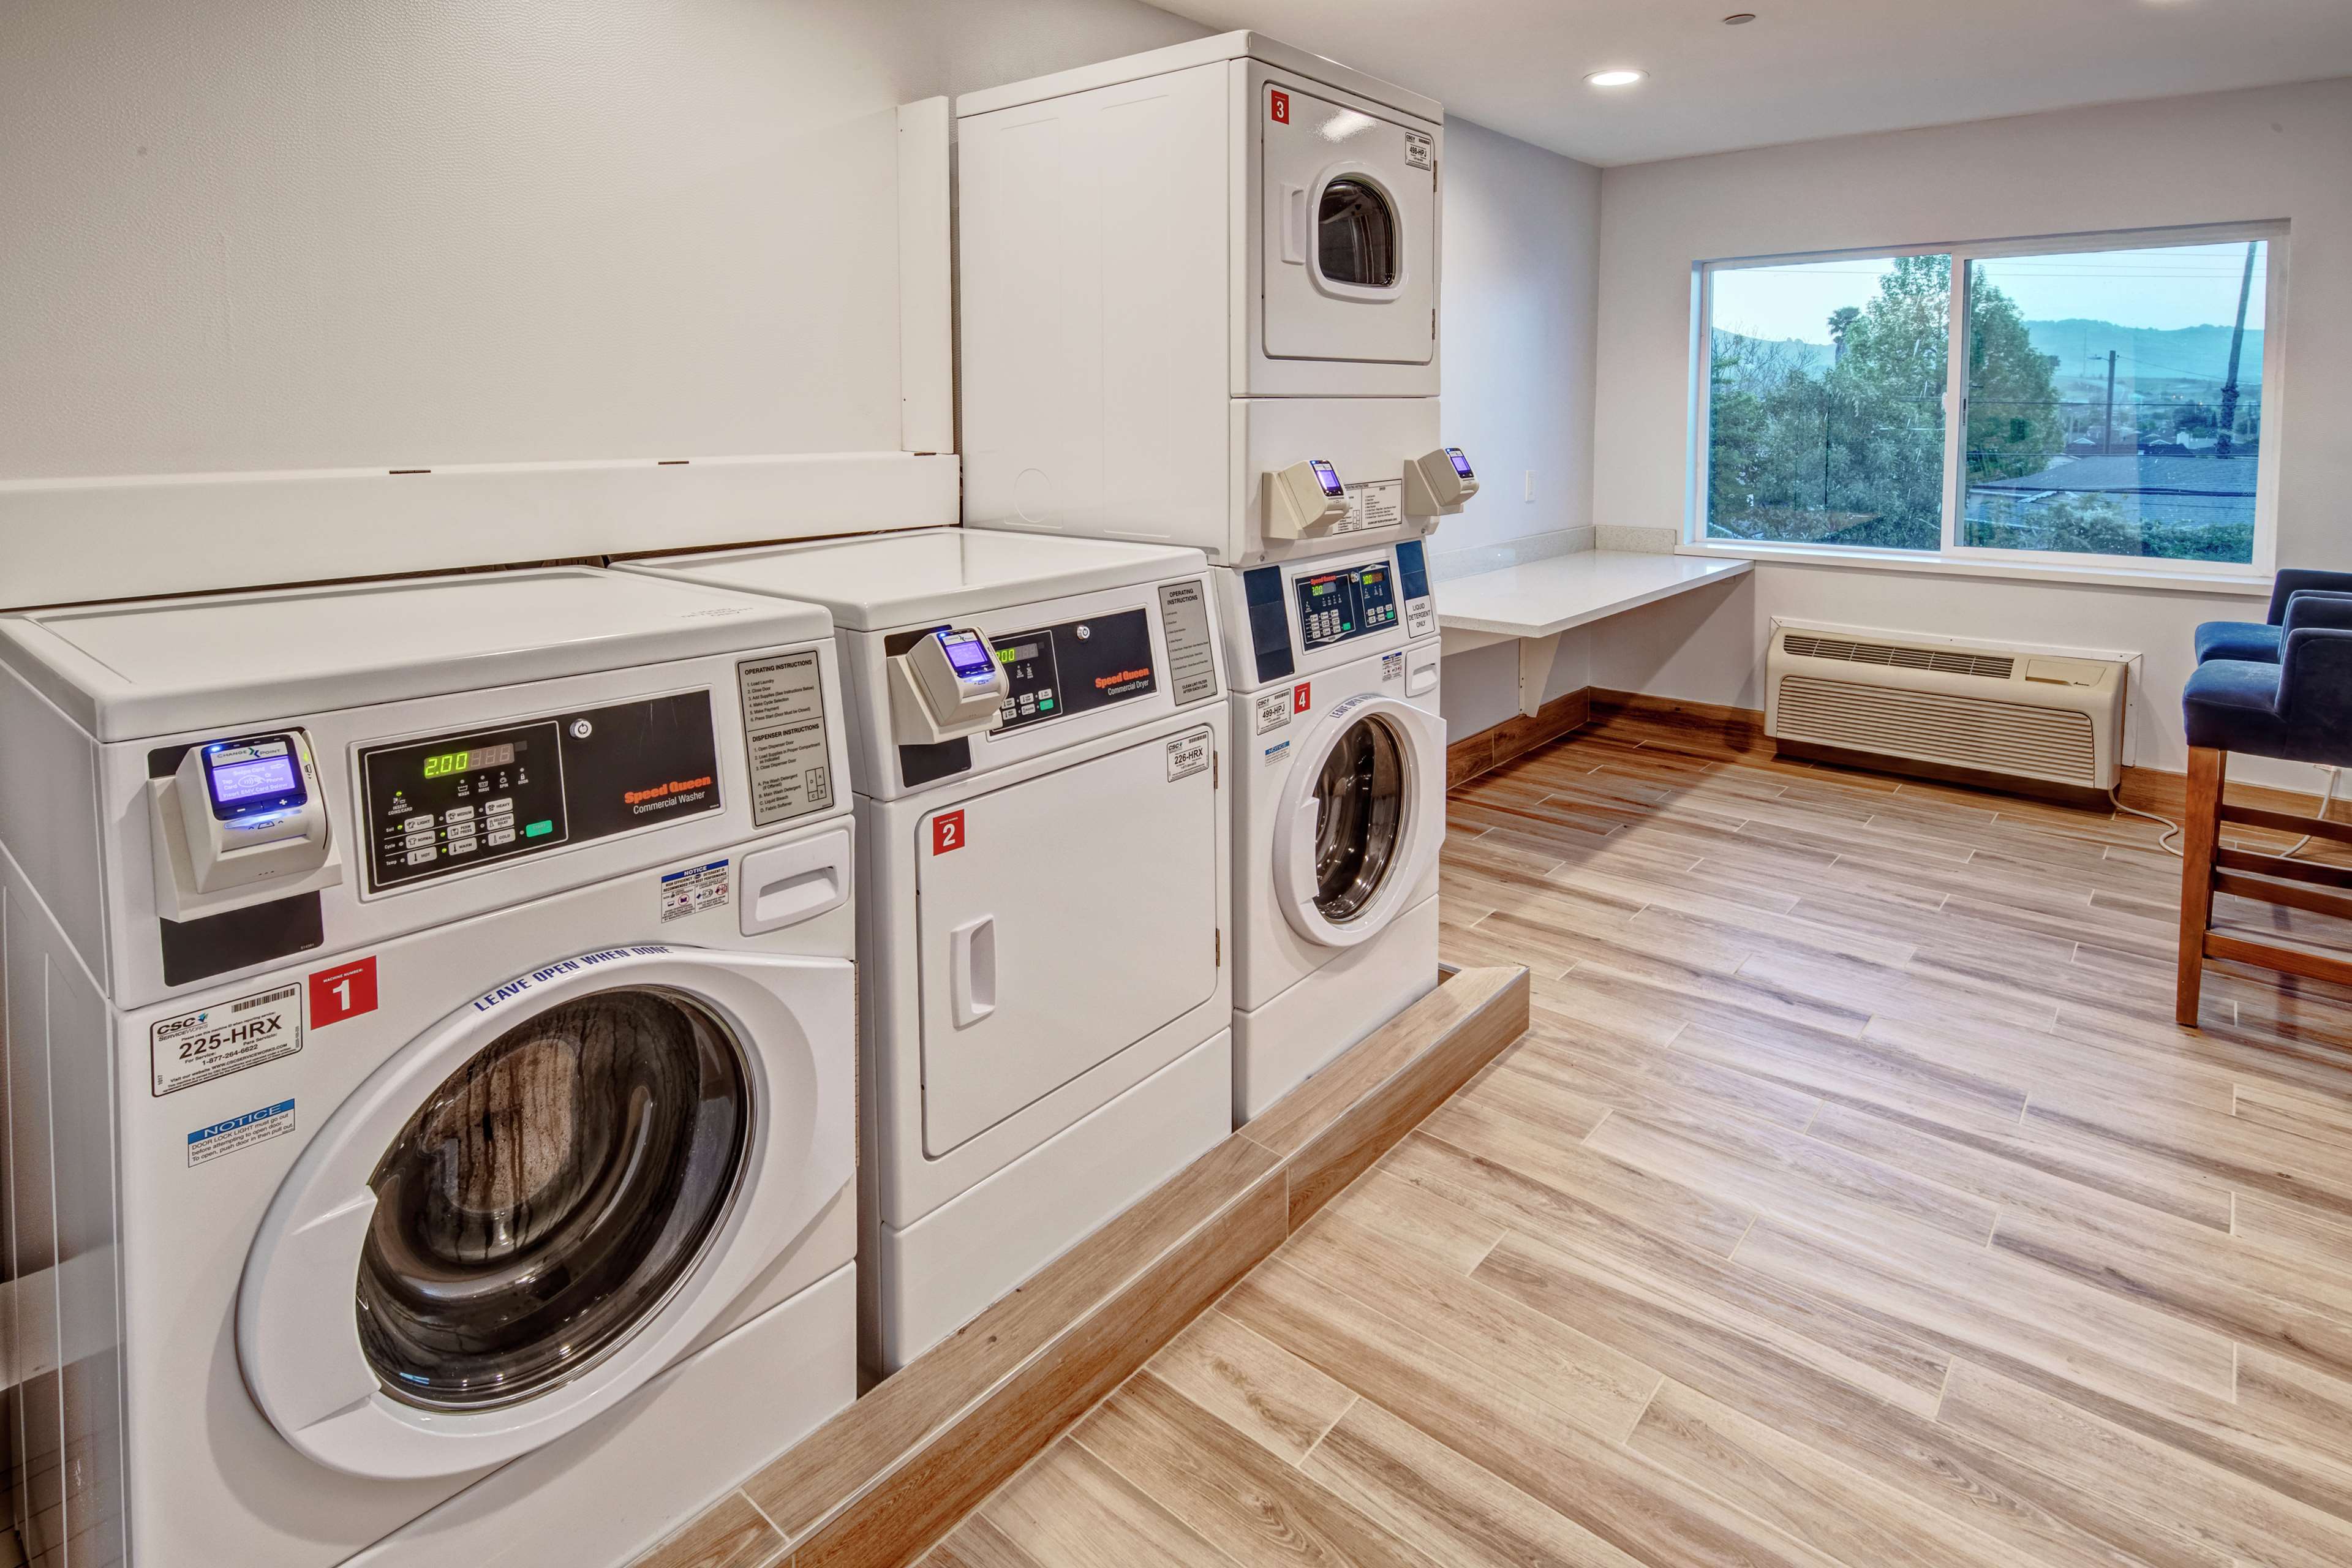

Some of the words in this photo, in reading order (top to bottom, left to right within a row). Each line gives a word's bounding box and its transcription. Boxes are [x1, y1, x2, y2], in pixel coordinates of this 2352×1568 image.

[1277, 101, 1284, 118] 3
[1167, 595, 1198, 605] INSTRUCTIONS
[1169, 588, 1194, 597] OPERATING
[1409, 609, 1430, 620] DETERGENT
[745, 665, 775, 675] OPERATING
[775, 659, 812, 670] INSTRUCTIONS
[1095, 673, 1122, 688] Speed
[1123, 668, 1150, 680] Queen
[1107, 682, 1136, 696] Commercial
[1136, 679, 1149, 689] Dryer
[1299, 691, 1306, 707] 4
[1262, 704, 1285, 718] 499-HPJ
[1329, 706, 1352, 718] LEAVE
[752, 731, 782, 742] DISPENSER
[783, 723, 820, 735] INSTRUCTIONS
[217, 750, 247, 758] CHANGE
[799, 742, 820, 750] Compartment
[1268, 743, 1286, 753] NOTICE
[1175, 747, 1203, 764] 226-HRX
[425, 753, 467, 776] 2.00
[624, 783, 668, 804] Speed
[669, 776, 711, 793] Queen
[388, 807, 413, 815] COINS/CARD
[633, 797, 677, 815] Commercial
[679, 791, 706, 804] Washer
[943, 823, 956, 846] 2
[684, 865, 707, 876] NOTICE
[323, 974, 344, 983] MACHINE
[344, 968, 363, 976] NUMBER:
[473, 978, 532, 1012] LEAVE
[532, 960, 581, 982] OPEN
[579, 949, 631, 965] WHEN
[630, 946, 673, 956] DONE
[333, 979, 350, 1011] 1
[157, 1017, 195, 1035] CSC
[179, 1014, 282, 1060] 225-HRX
[255, 1033, 277, 1042] Servicio:
[195, 1052, 216, 1061] Service:
[202, 1044, 258, 1066] 1-877-264-6622
[204, 1104, 281, 1137] NOTICE
[192, 1139, 213, 1150] DOOR
[214, 1132, 232, 1142] LOCK
[234, 1125, 254, 1136] LIGHT
[255, 1120, 269, 1128] must
[192, 1146, 211, 1156] before
[213, 1133, 244, 1148] attempting
[252, 1127, 267, 1136] open
[268, 1121, 282, 1129] door.
[201, 1151, 218, 1159] open,
[219, 1144, 235, 1153] push
[236, 1138, 249, 1147] door
[257, 1131, 271, 1139] then
[272, 1126, 282, 1135] pull
